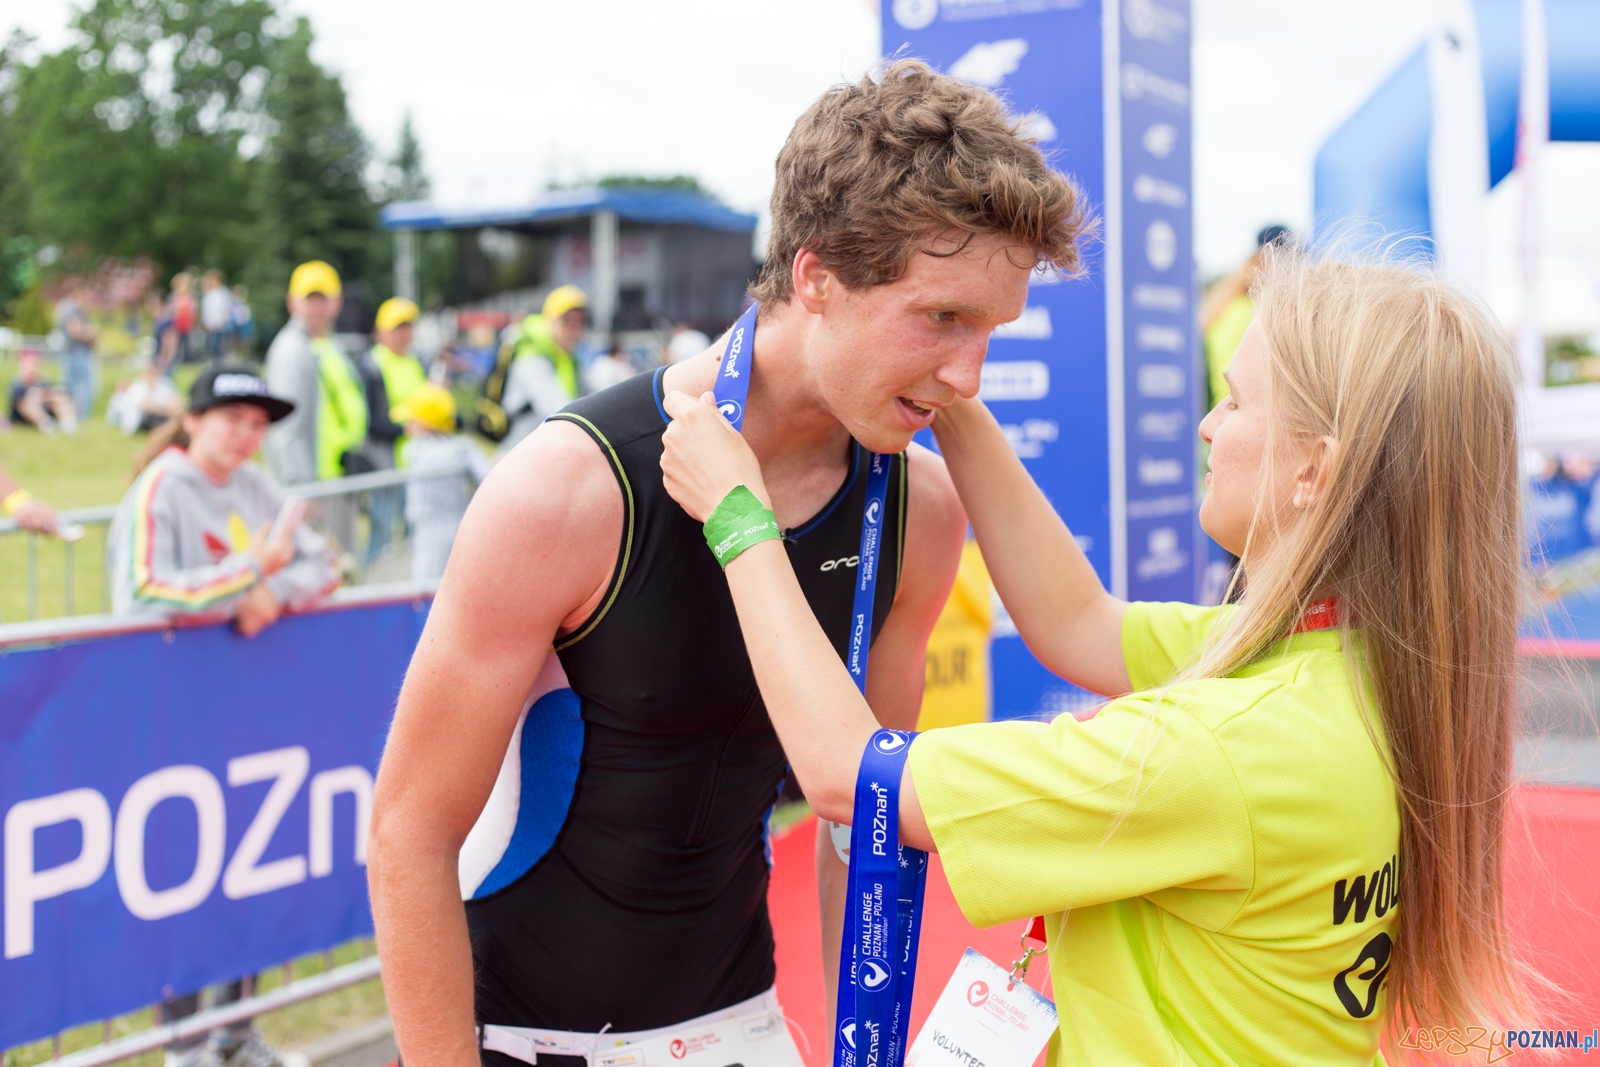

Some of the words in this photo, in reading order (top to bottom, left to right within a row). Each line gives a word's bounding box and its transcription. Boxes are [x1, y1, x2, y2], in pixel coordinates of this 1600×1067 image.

[820, 555, 860, 571] orc
[867, 528, 878, 581] CHALLENGE
[4, 745, 376, 960] POZn
[874, 882, 883, 917] POLAND
[862, 891, 873, 956] CHALLENGE
[990, 993, 1029, 1022] CHALLENGE
